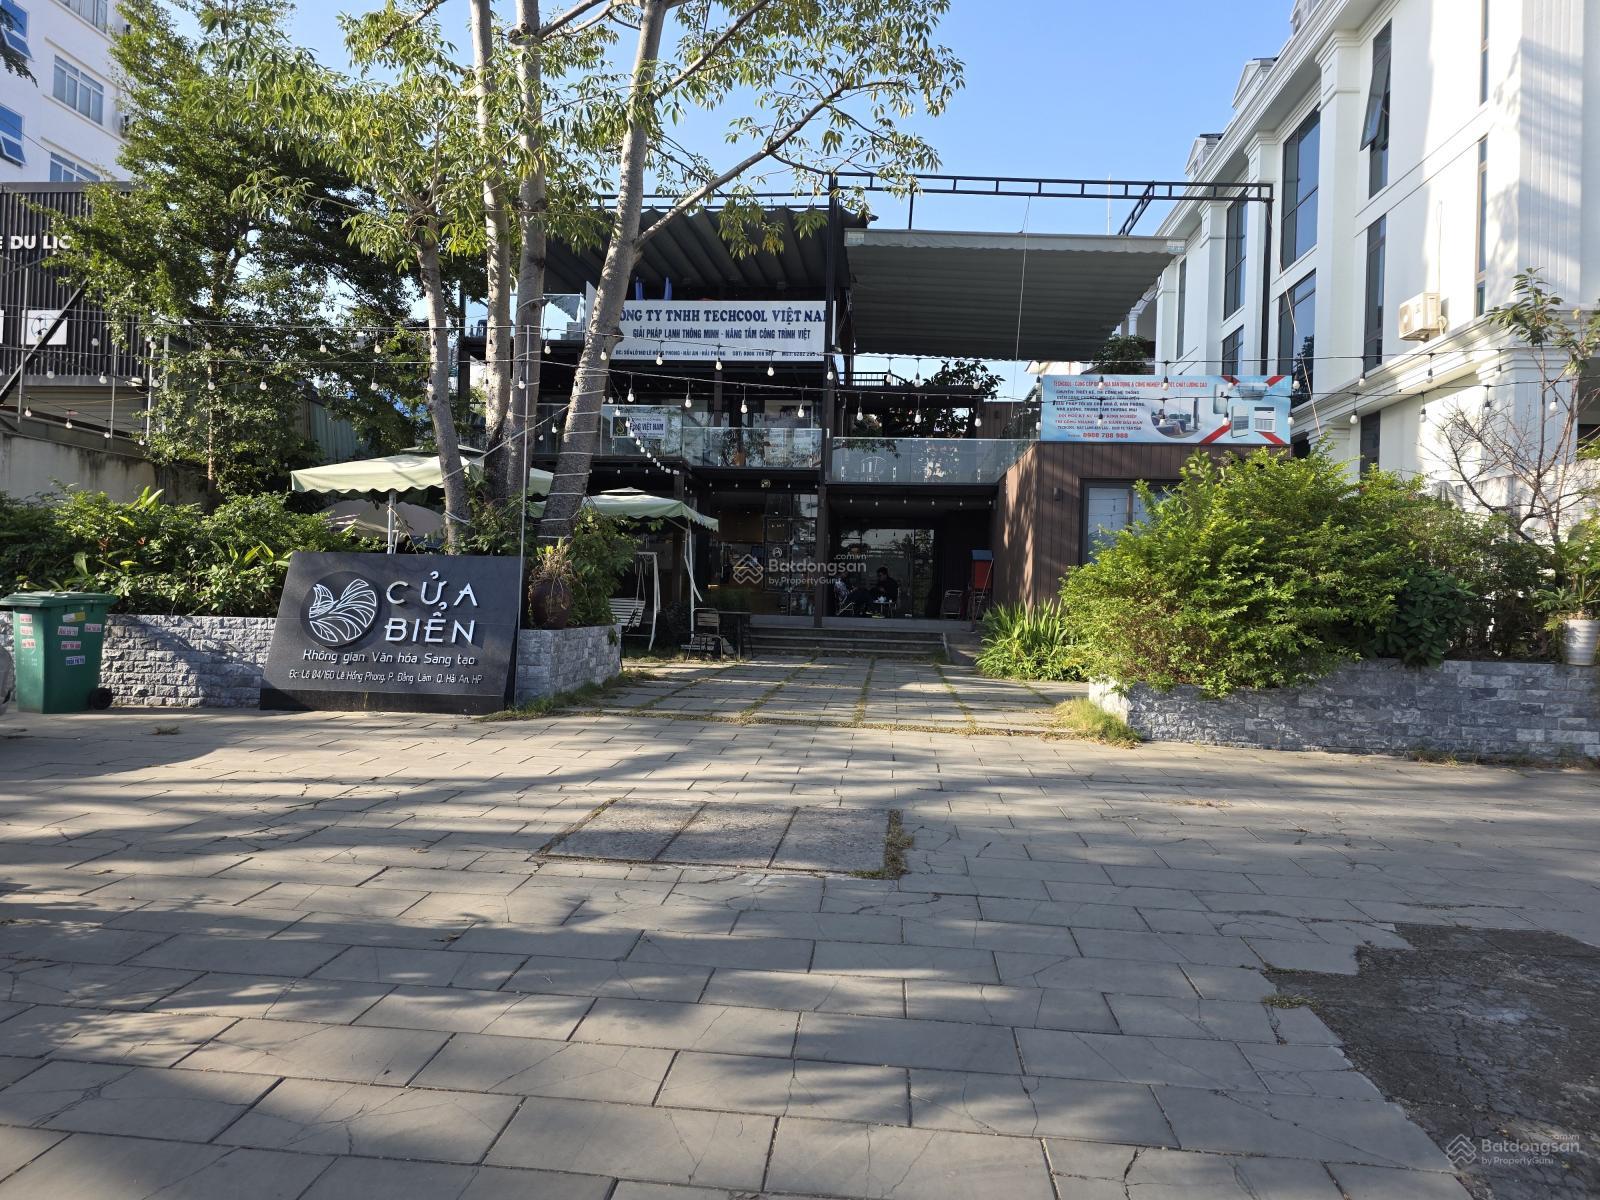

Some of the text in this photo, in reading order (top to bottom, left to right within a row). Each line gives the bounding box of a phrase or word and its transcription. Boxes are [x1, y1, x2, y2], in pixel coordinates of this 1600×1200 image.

[10, 235, 36, 250] DU
[619, 307, 643, 323] ÔNG
[645, 309, 663, 323] TY
[665, 309, 700, 323] TNHH
[703, 310, 768, 323] TECHCOOL
[772, 306, 802, 325] VIỆT
[646, 327, 663, 339] PHÁP
[664, 328, 681, 341] LẠNH
[682, 327, 702, 339] THÔNG
[703, 329, 720, 340] MINH
[797, 327, 811, 341] VIỆT
[386, 571, 478, 607] CỬA
[384, 602, 476, 646] BIỂN
[303, 649, 338, 664] Không
[343, 651, 365, 665] gian
[372, 652, 393, 663] Văn
[398, 652, 418, 664] hóa
[457, 653, 475, 667] tạo
[336, 670, 345, 680] Lê
[347, 669, 363, 683] Hồng
